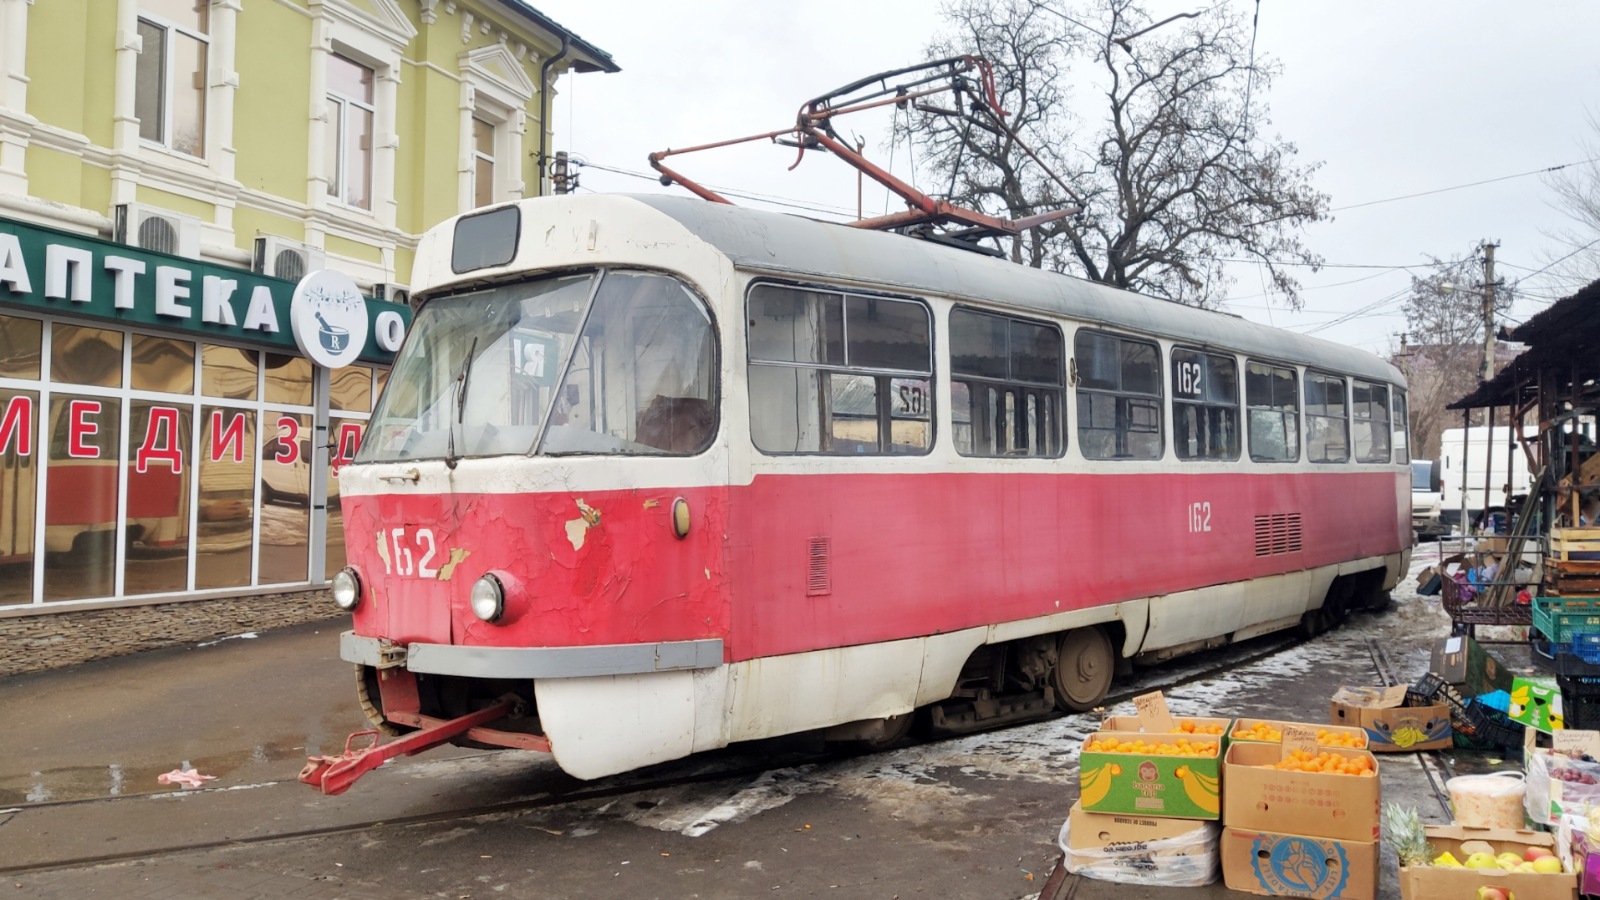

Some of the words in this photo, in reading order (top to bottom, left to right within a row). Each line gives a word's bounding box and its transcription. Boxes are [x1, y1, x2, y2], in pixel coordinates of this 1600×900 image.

[0, 233, 280, 333] АПТЕКА
[1177, 361, 1202, 395] 162
[1188, 502, 1212, 533] 162
[377, 528, 439, 578] 162
